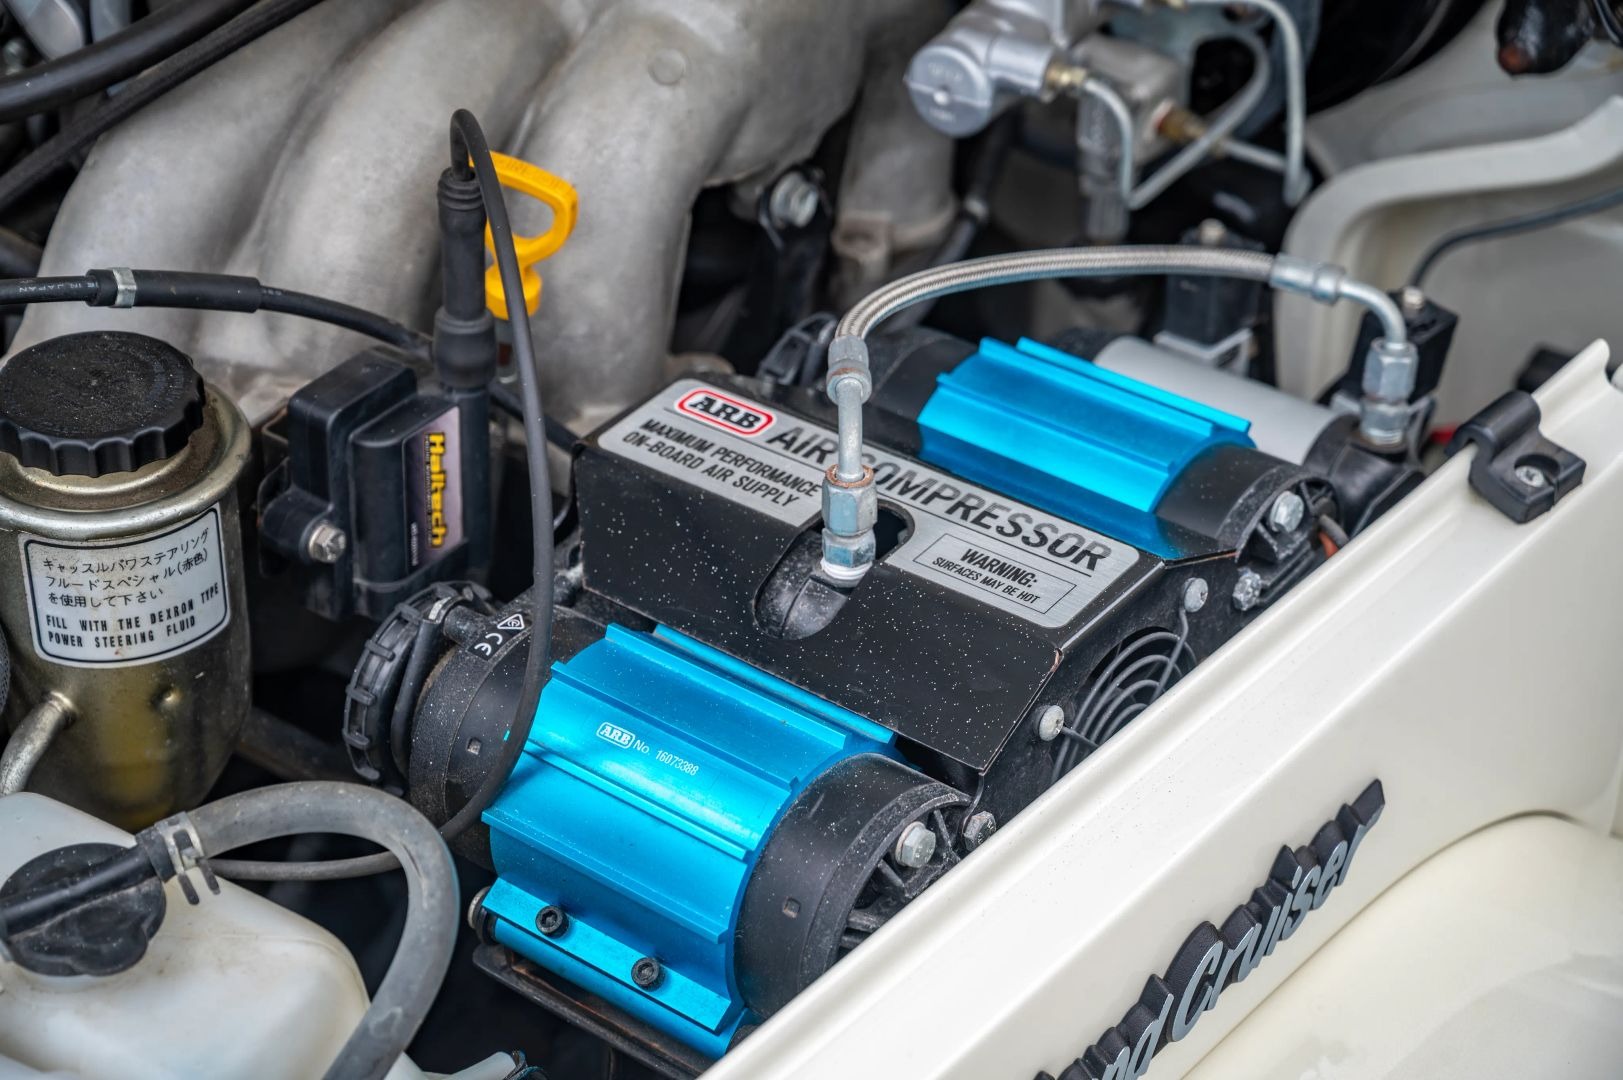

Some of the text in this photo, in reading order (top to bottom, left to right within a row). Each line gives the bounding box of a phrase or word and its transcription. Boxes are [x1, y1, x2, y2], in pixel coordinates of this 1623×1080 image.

[19, 283, 64, 293] JAPAN
[689, 396, 761, 429] ARB
[641, 419, 822, 497] MAXIMUM PERFORMANCE
[766, 427, 838, 464] AIR
[429, 432, 446, 546] Haltech
[623, 432, 799, 507] ON-BOARD AIR SUPPLY
[932, 557, 1041, 604] SURFACES MAY BE HOT
[960, 548, 1038, 588] WARNING:
[46, 582, 219, 632] FILL WITH THE DEXRON TYPE
[48, 588, 163, 608] を使用して下さい
[48, 615, 196, 648] POWER STEERING FLUID
[599, 724, 632, 746] ARB
[655, 750, 699, 776] 16073388
[1168, 780, 1385, 1042] Cruiser
